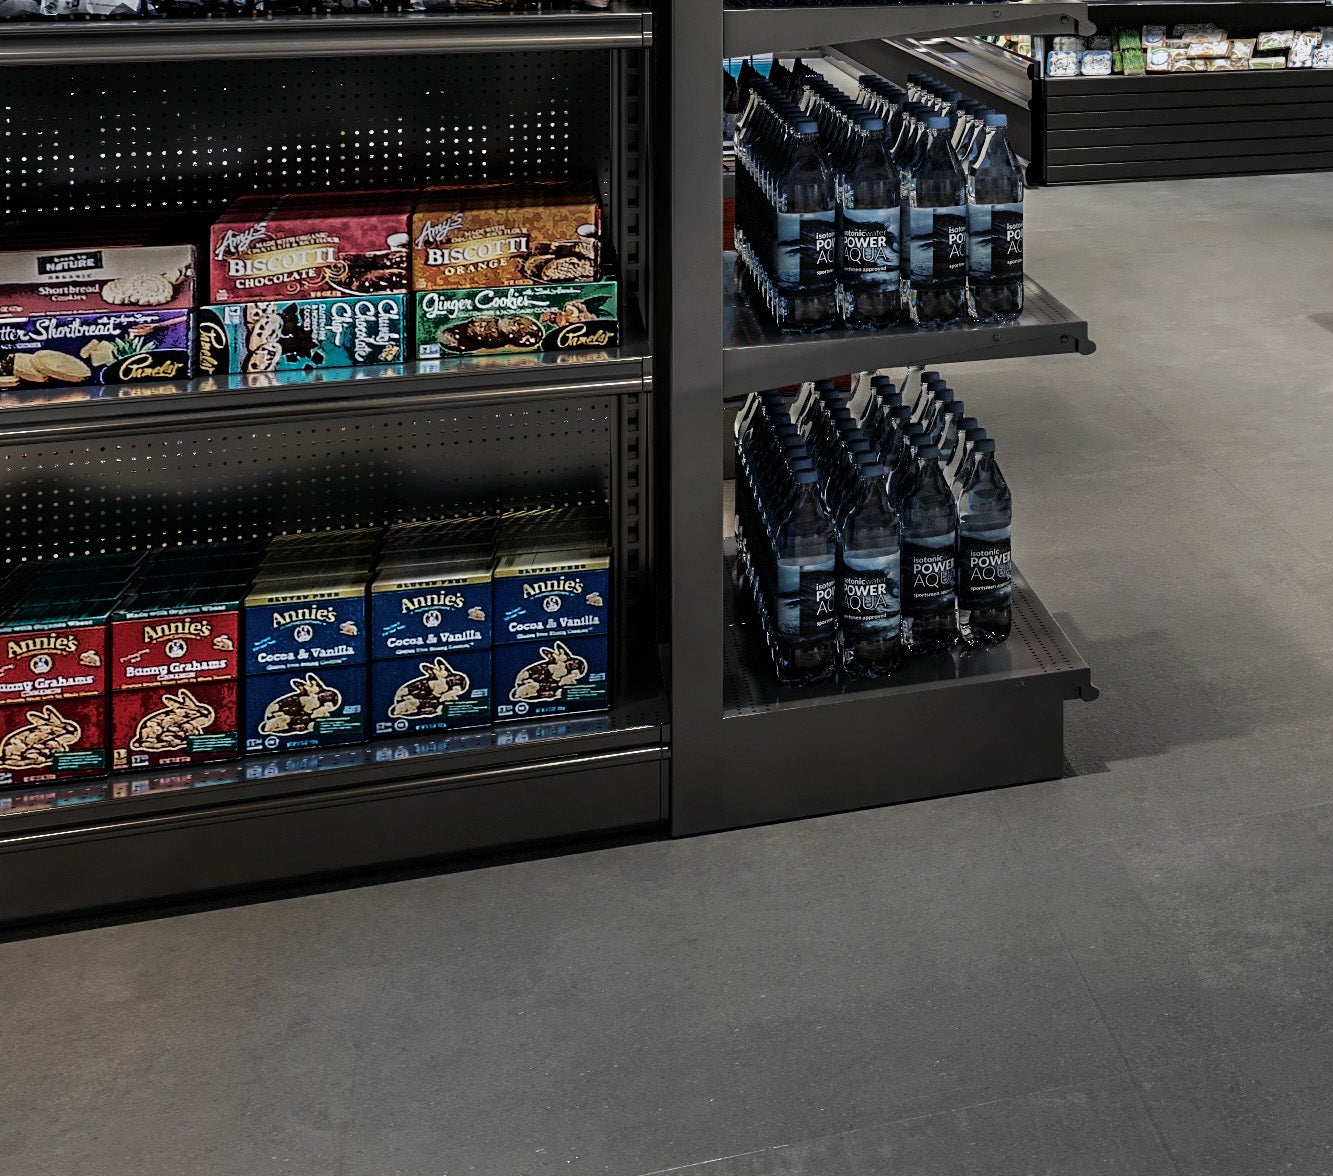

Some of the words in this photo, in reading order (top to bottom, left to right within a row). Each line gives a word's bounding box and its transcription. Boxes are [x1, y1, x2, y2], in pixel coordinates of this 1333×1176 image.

[215, 223, 267, 261] Amy's
[415, 213, 464, 249] Amy's
[228, 246, 338, 277] BISCOTTI
[427, 237, 528, 266] BISCOTTI
[236, 267, 317, 289] CHOCOLATE
[444, 258, 508, 276] ORANGE
[38, 284, 100, 296] Shortbread
[423, 293, 473, 319] Ginger
[475, 289, 550, 310] Cookies
[30, 318, 121, 340] Shortbread
[326, 302, 353, 347] Chip
[354, 301, 376, 362] Chocolate
[518, 567, 557, 575] GLUTEN
[523, 576, 584, 599] Annie's
[401, 590, 464, 614] Annie's
[273, 604, 337, 628] Annie's
[509, 621, 544, 633] Cocoa
[560, 615, 600, 627] Vanilla
[144, 618, 212, 643] Annie's
[387, 635, 424, 648] Cocoa
[440, 629, 482, 642] Vanilla
[8, 633, 78, 659] Annie's
[258, 650, 295, 663] Cocoa
[312, 645, 355, 657] Vanilla
[126, 664, 168, 678] Bunny
[169, 659, 227, 673] Grahams
[35, 675, 95, 690] Grahams
